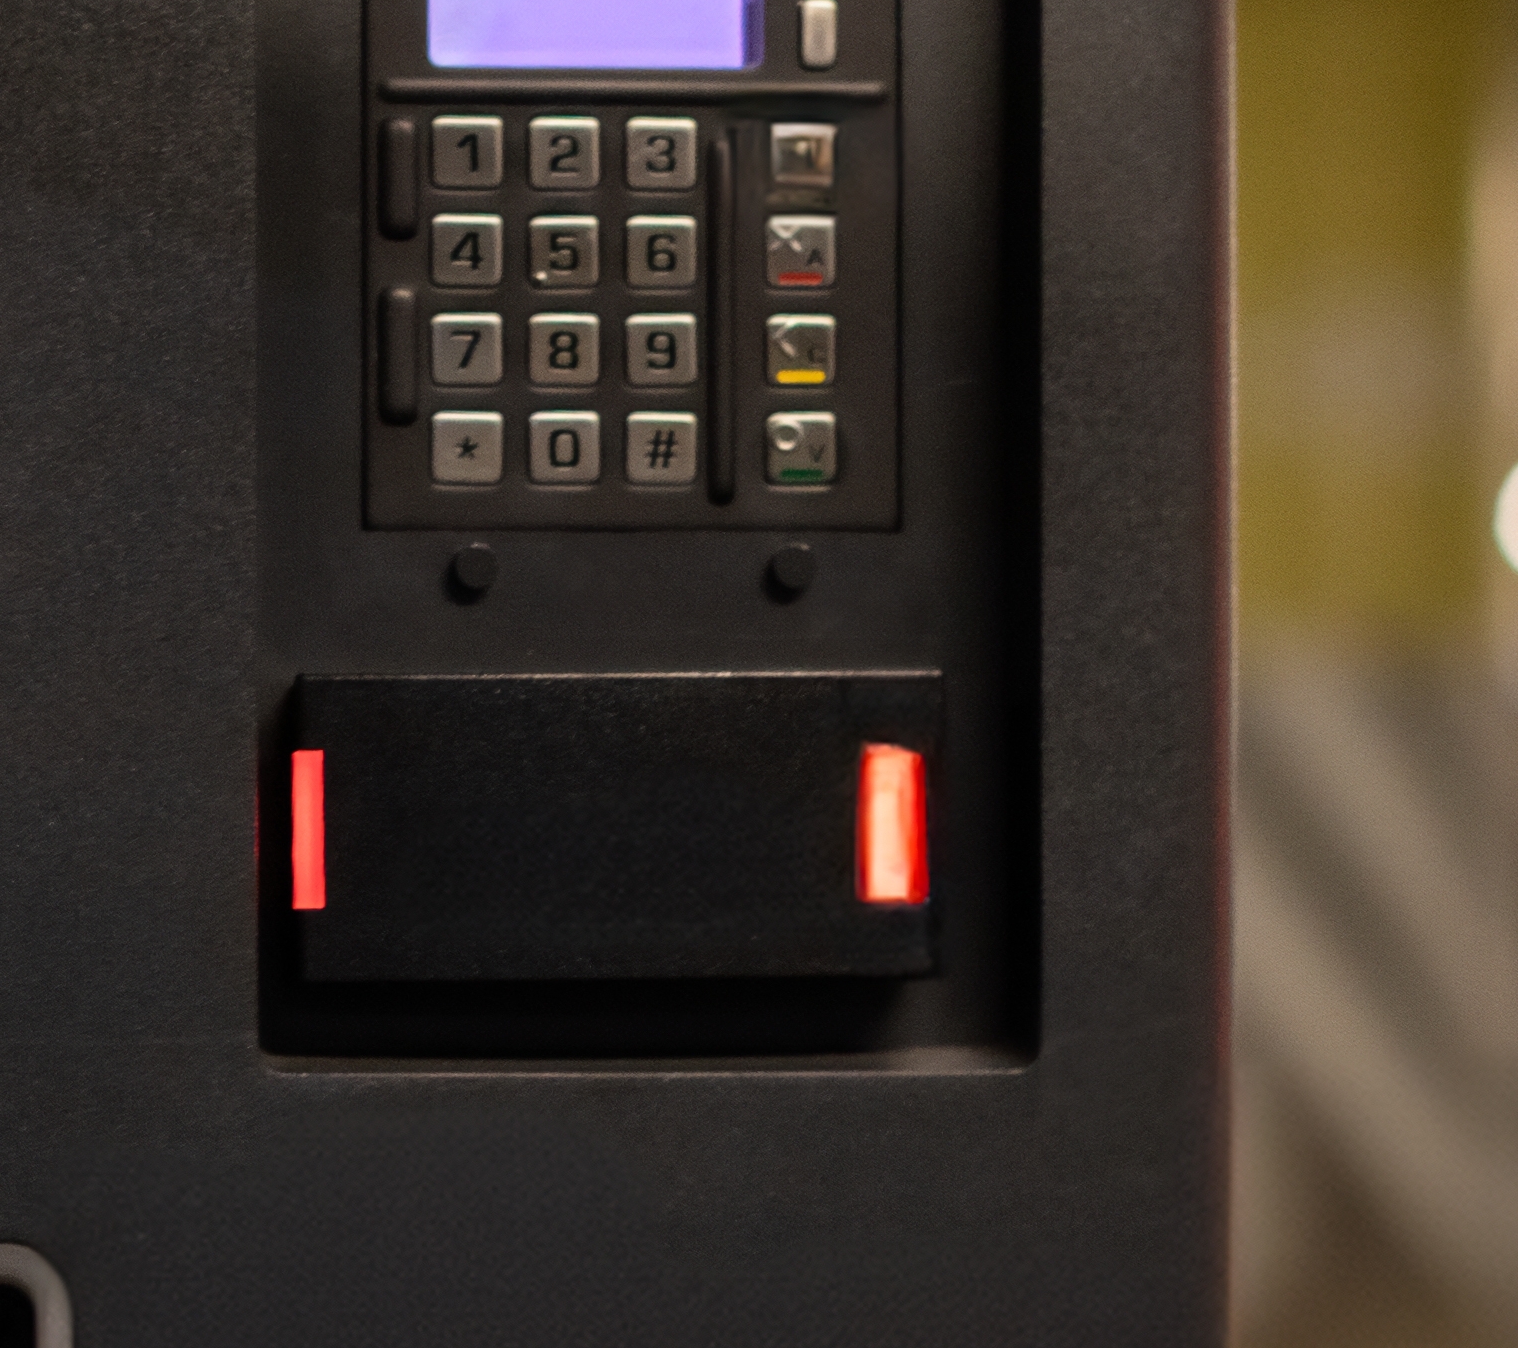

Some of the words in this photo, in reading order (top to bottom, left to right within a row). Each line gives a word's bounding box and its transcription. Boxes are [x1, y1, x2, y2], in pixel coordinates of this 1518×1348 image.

[456, 133, 479, 172] 1
[549, 135, 580, 173] 2
[646, 135, 677, 173] 3
[450, 231, 483, 270] 4
[549, 232, 580, 271] 5
[647, 233, 677, 272] 6
[450, 329, 482, 369] 7
[548, 330, 580, 369] 8
[646, 331, 677, 369] 9
[548, 429, 580, 468] 0
[646, 430, 678, 468] #
